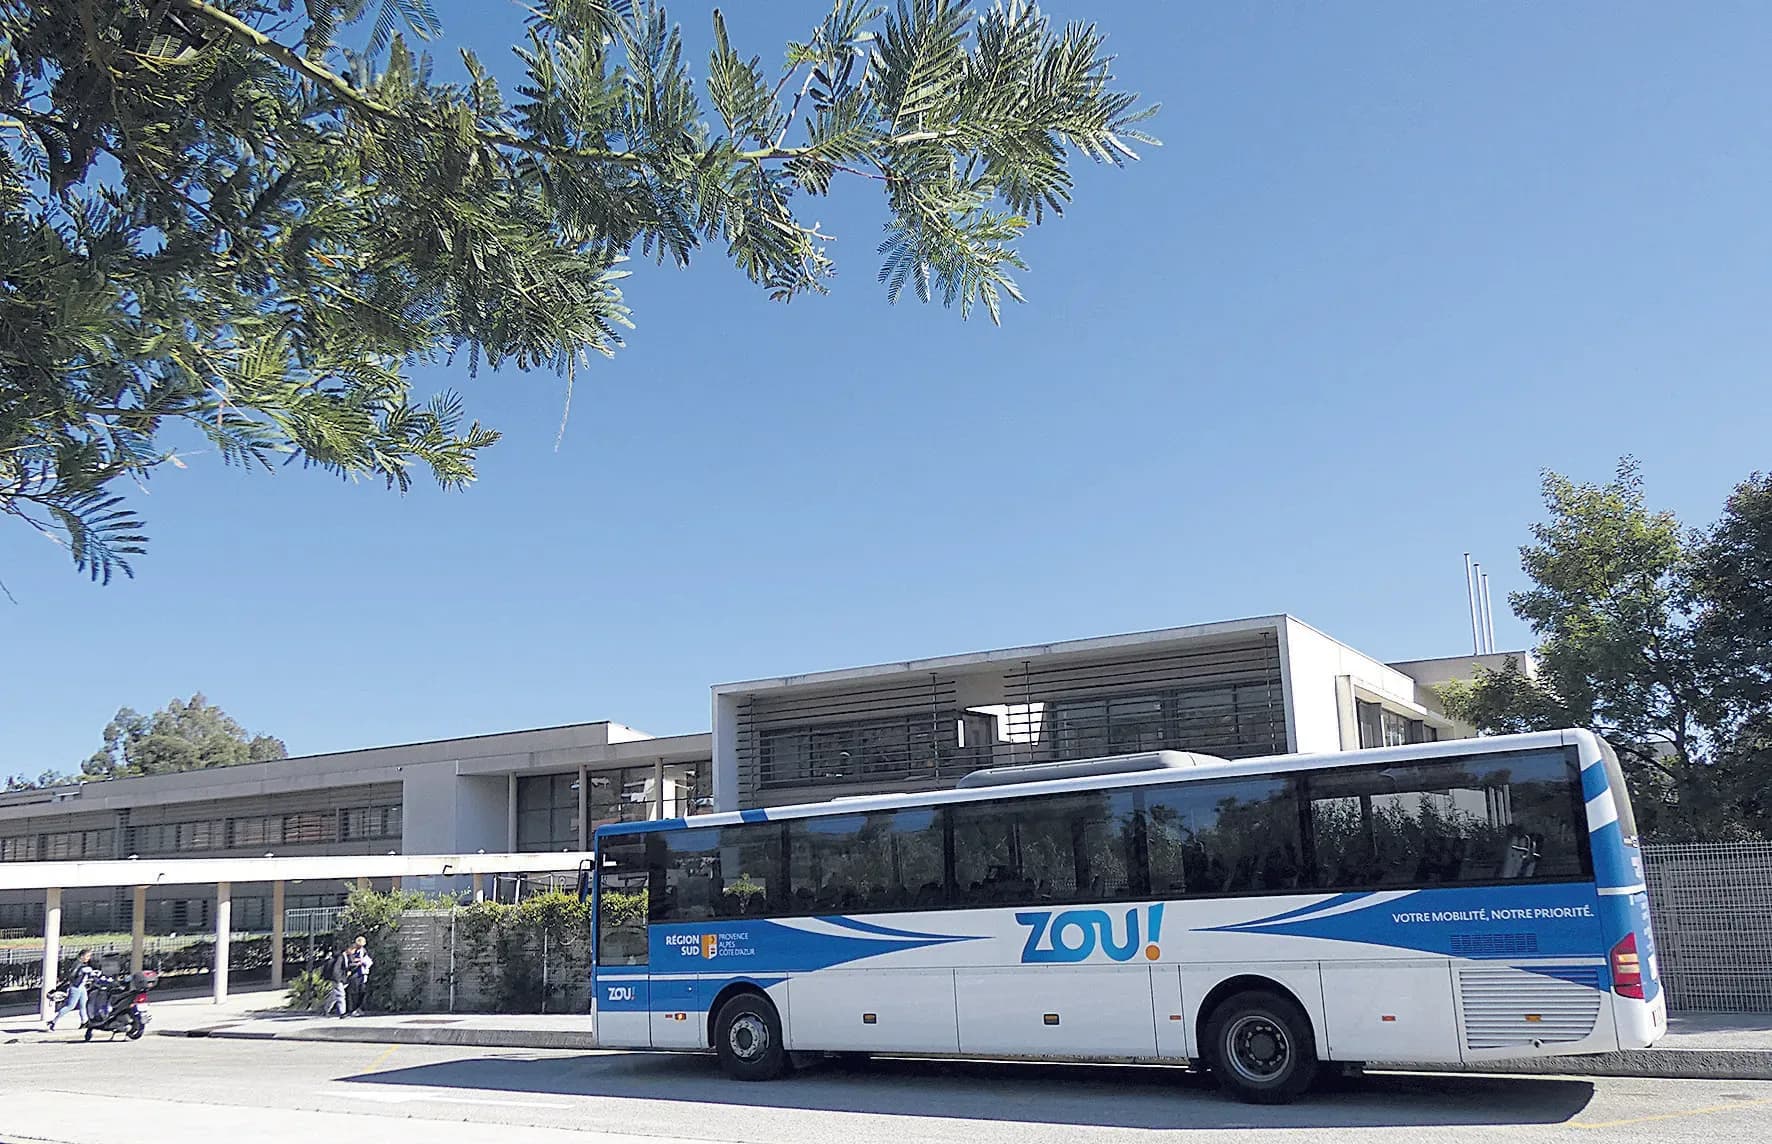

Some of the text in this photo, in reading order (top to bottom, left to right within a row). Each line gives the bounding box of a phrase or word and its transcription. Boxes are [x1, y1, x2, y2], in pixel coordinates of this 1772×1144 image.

[1392, 904, 1594, 923] VOTRE MOBILITÉ, NOTRE PRIORITÉ.
[665, 934, 700, 945] RÉGION
[1015, 903, 1165, 963] ZOU!
[681, 946, 700, 956] SUD
[607, 986, 636, 1001] ZOU!
